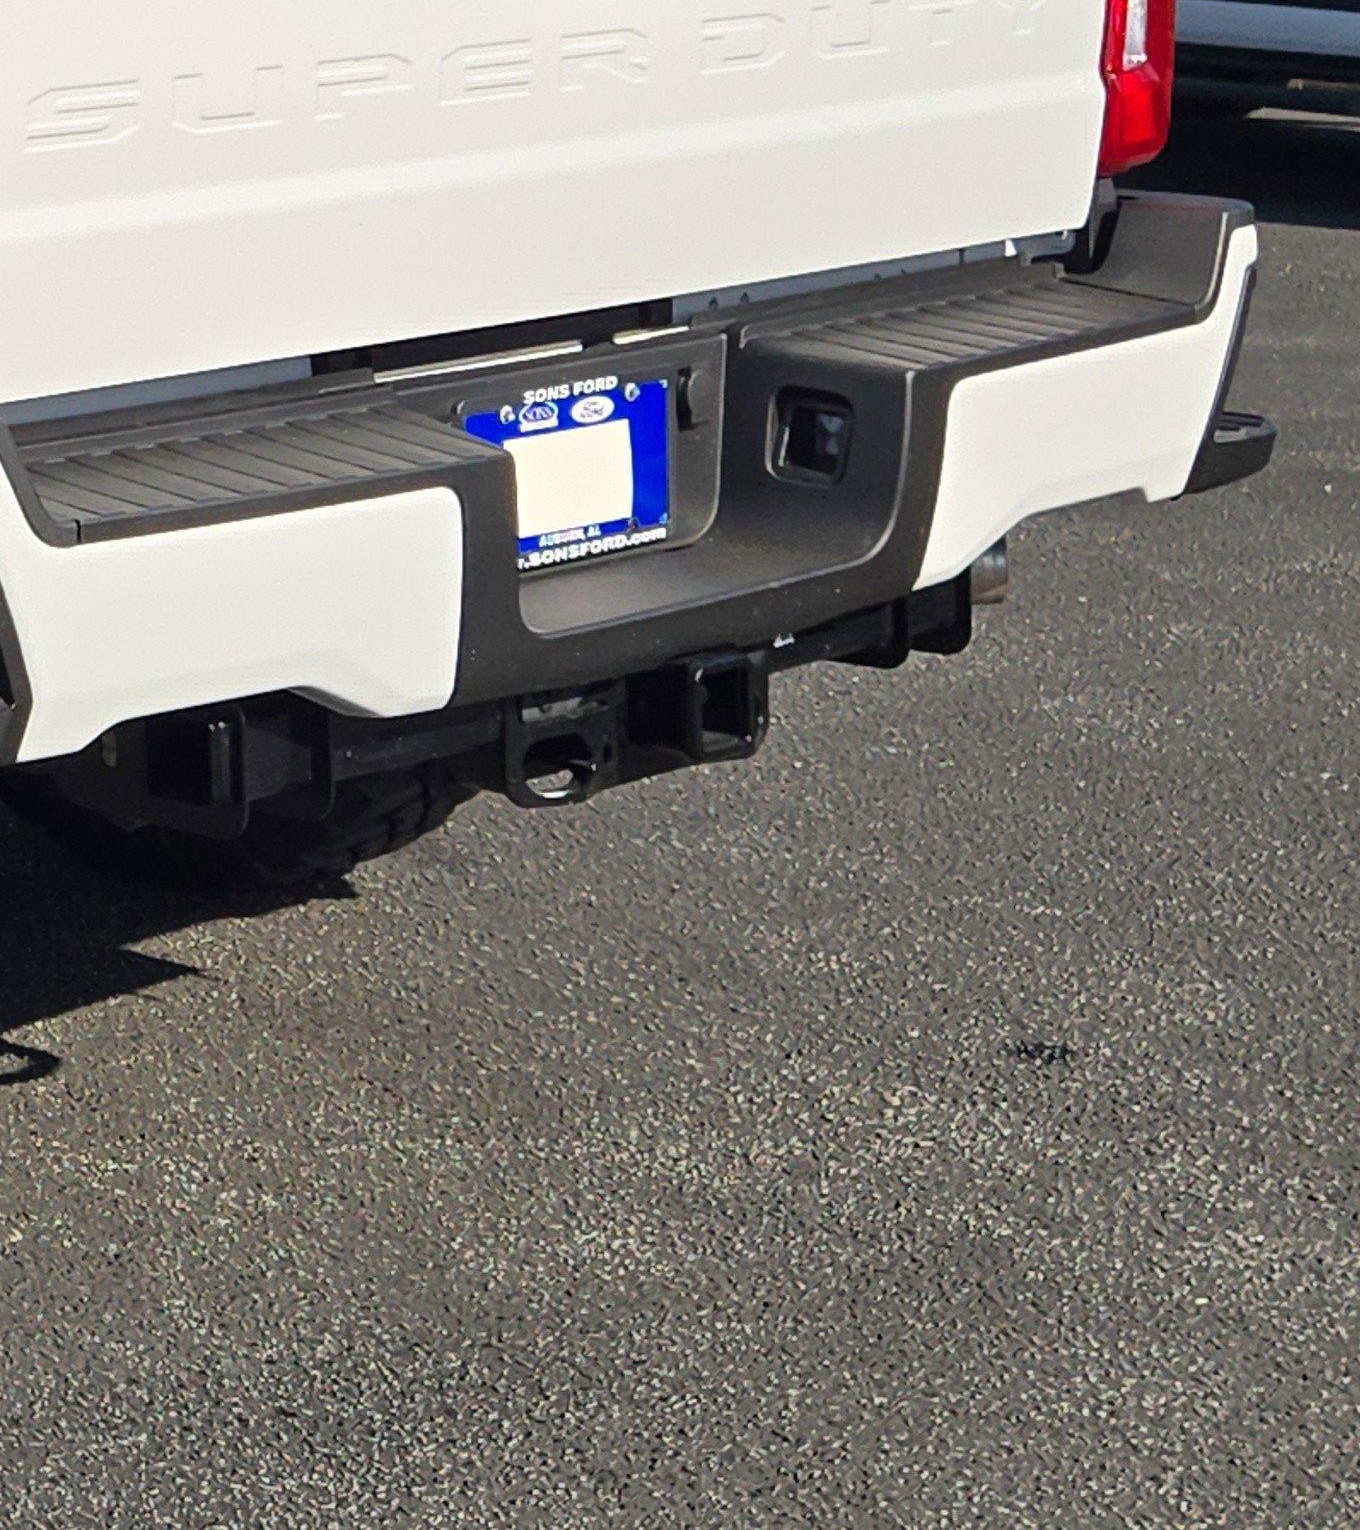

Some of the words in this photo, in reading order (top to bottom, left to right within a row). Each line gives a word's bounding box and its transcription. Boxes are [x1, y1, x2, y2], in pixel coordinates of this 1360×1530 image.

[24, 26, 650, 153] SUPER
[522, 384, 571, 405] SONS
[572, 375, 619, 396] FORD
